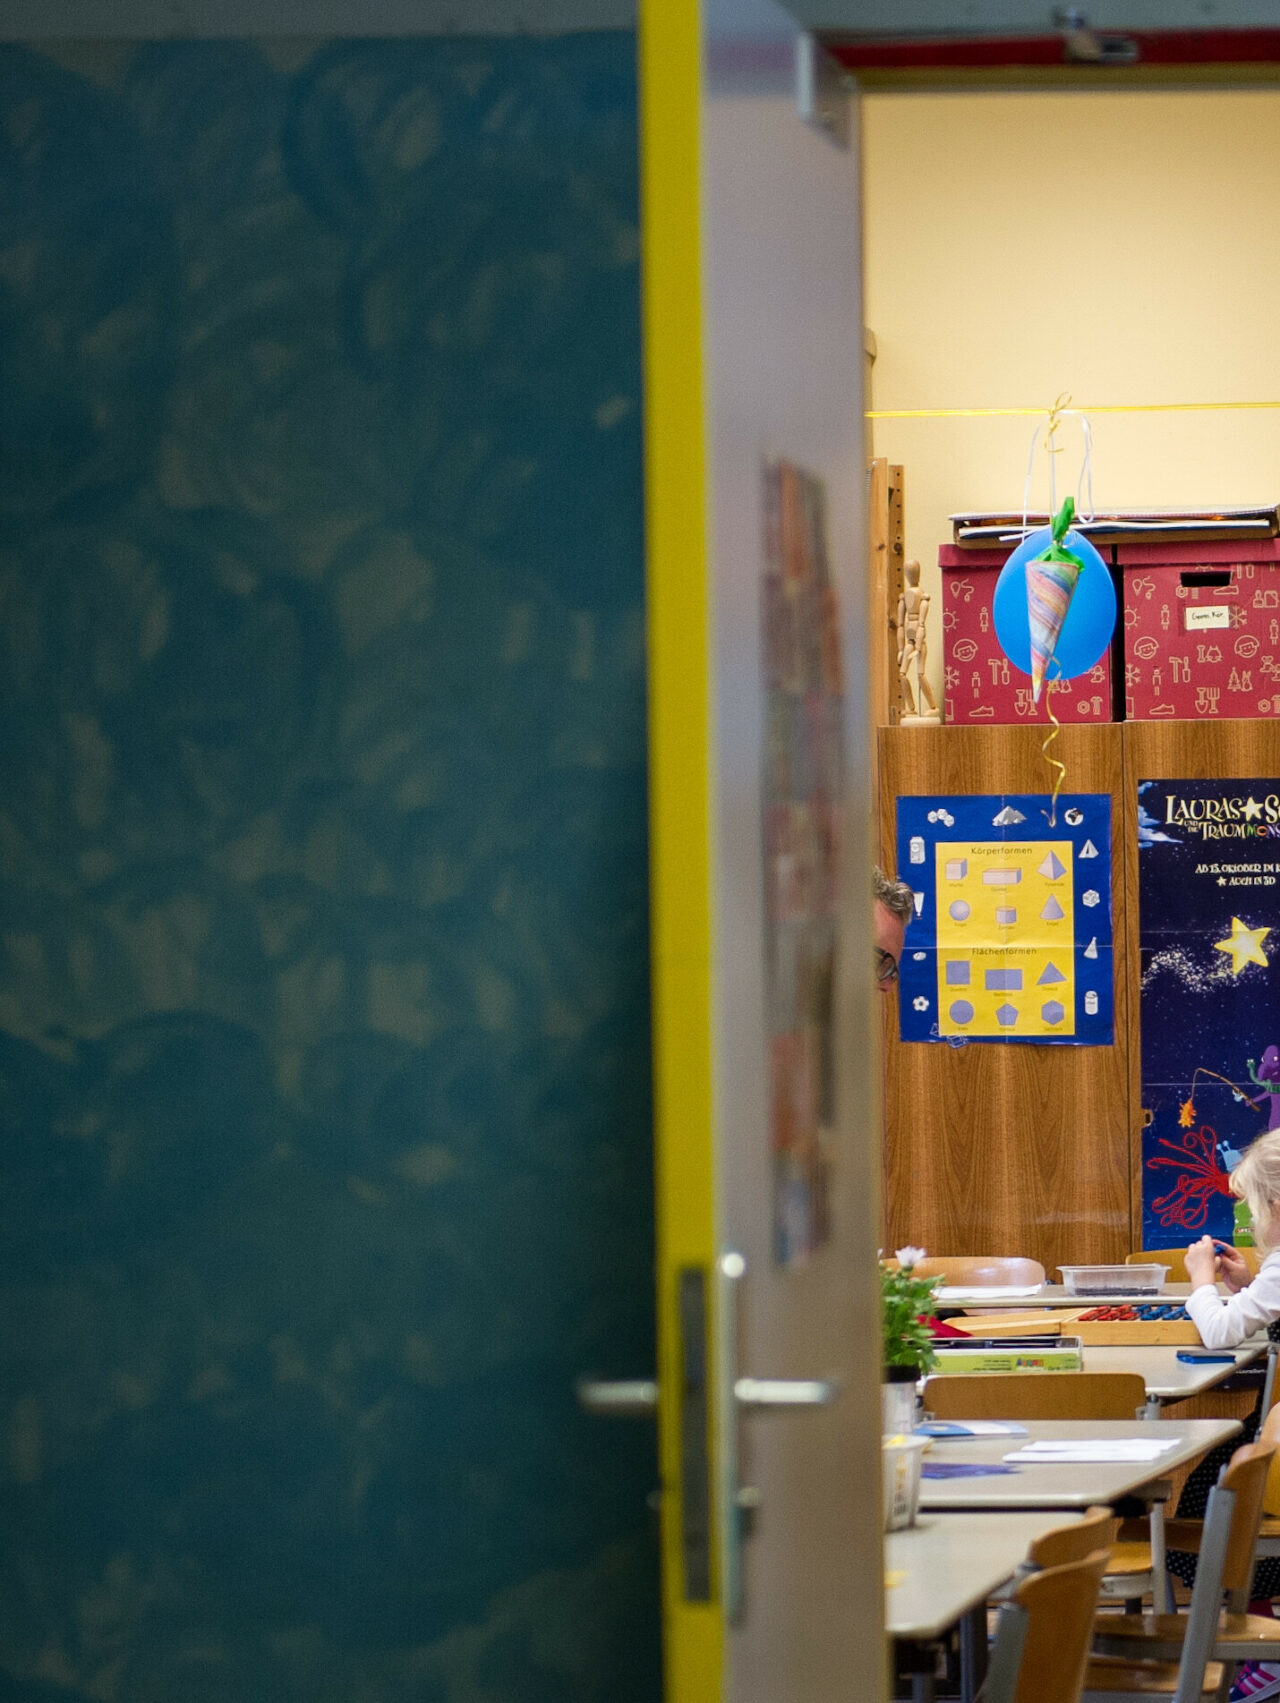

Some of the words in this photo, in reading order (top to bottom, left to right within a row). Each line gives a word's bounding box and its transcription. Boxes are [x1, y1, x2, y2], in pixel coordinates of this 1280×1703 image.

[1165, 795, 1242, 825] LAURAS
[971, 847, 1033, 856] Körperformen
[1221, 863, 1262, 873] OKTOBER
[1228, 876, 1252, 886] AUCH
[1254, 876, 1262, 885] IN
[1263, 876, 1276, 886] 3D
[972, 947, 1037, 956] Flächenformen
